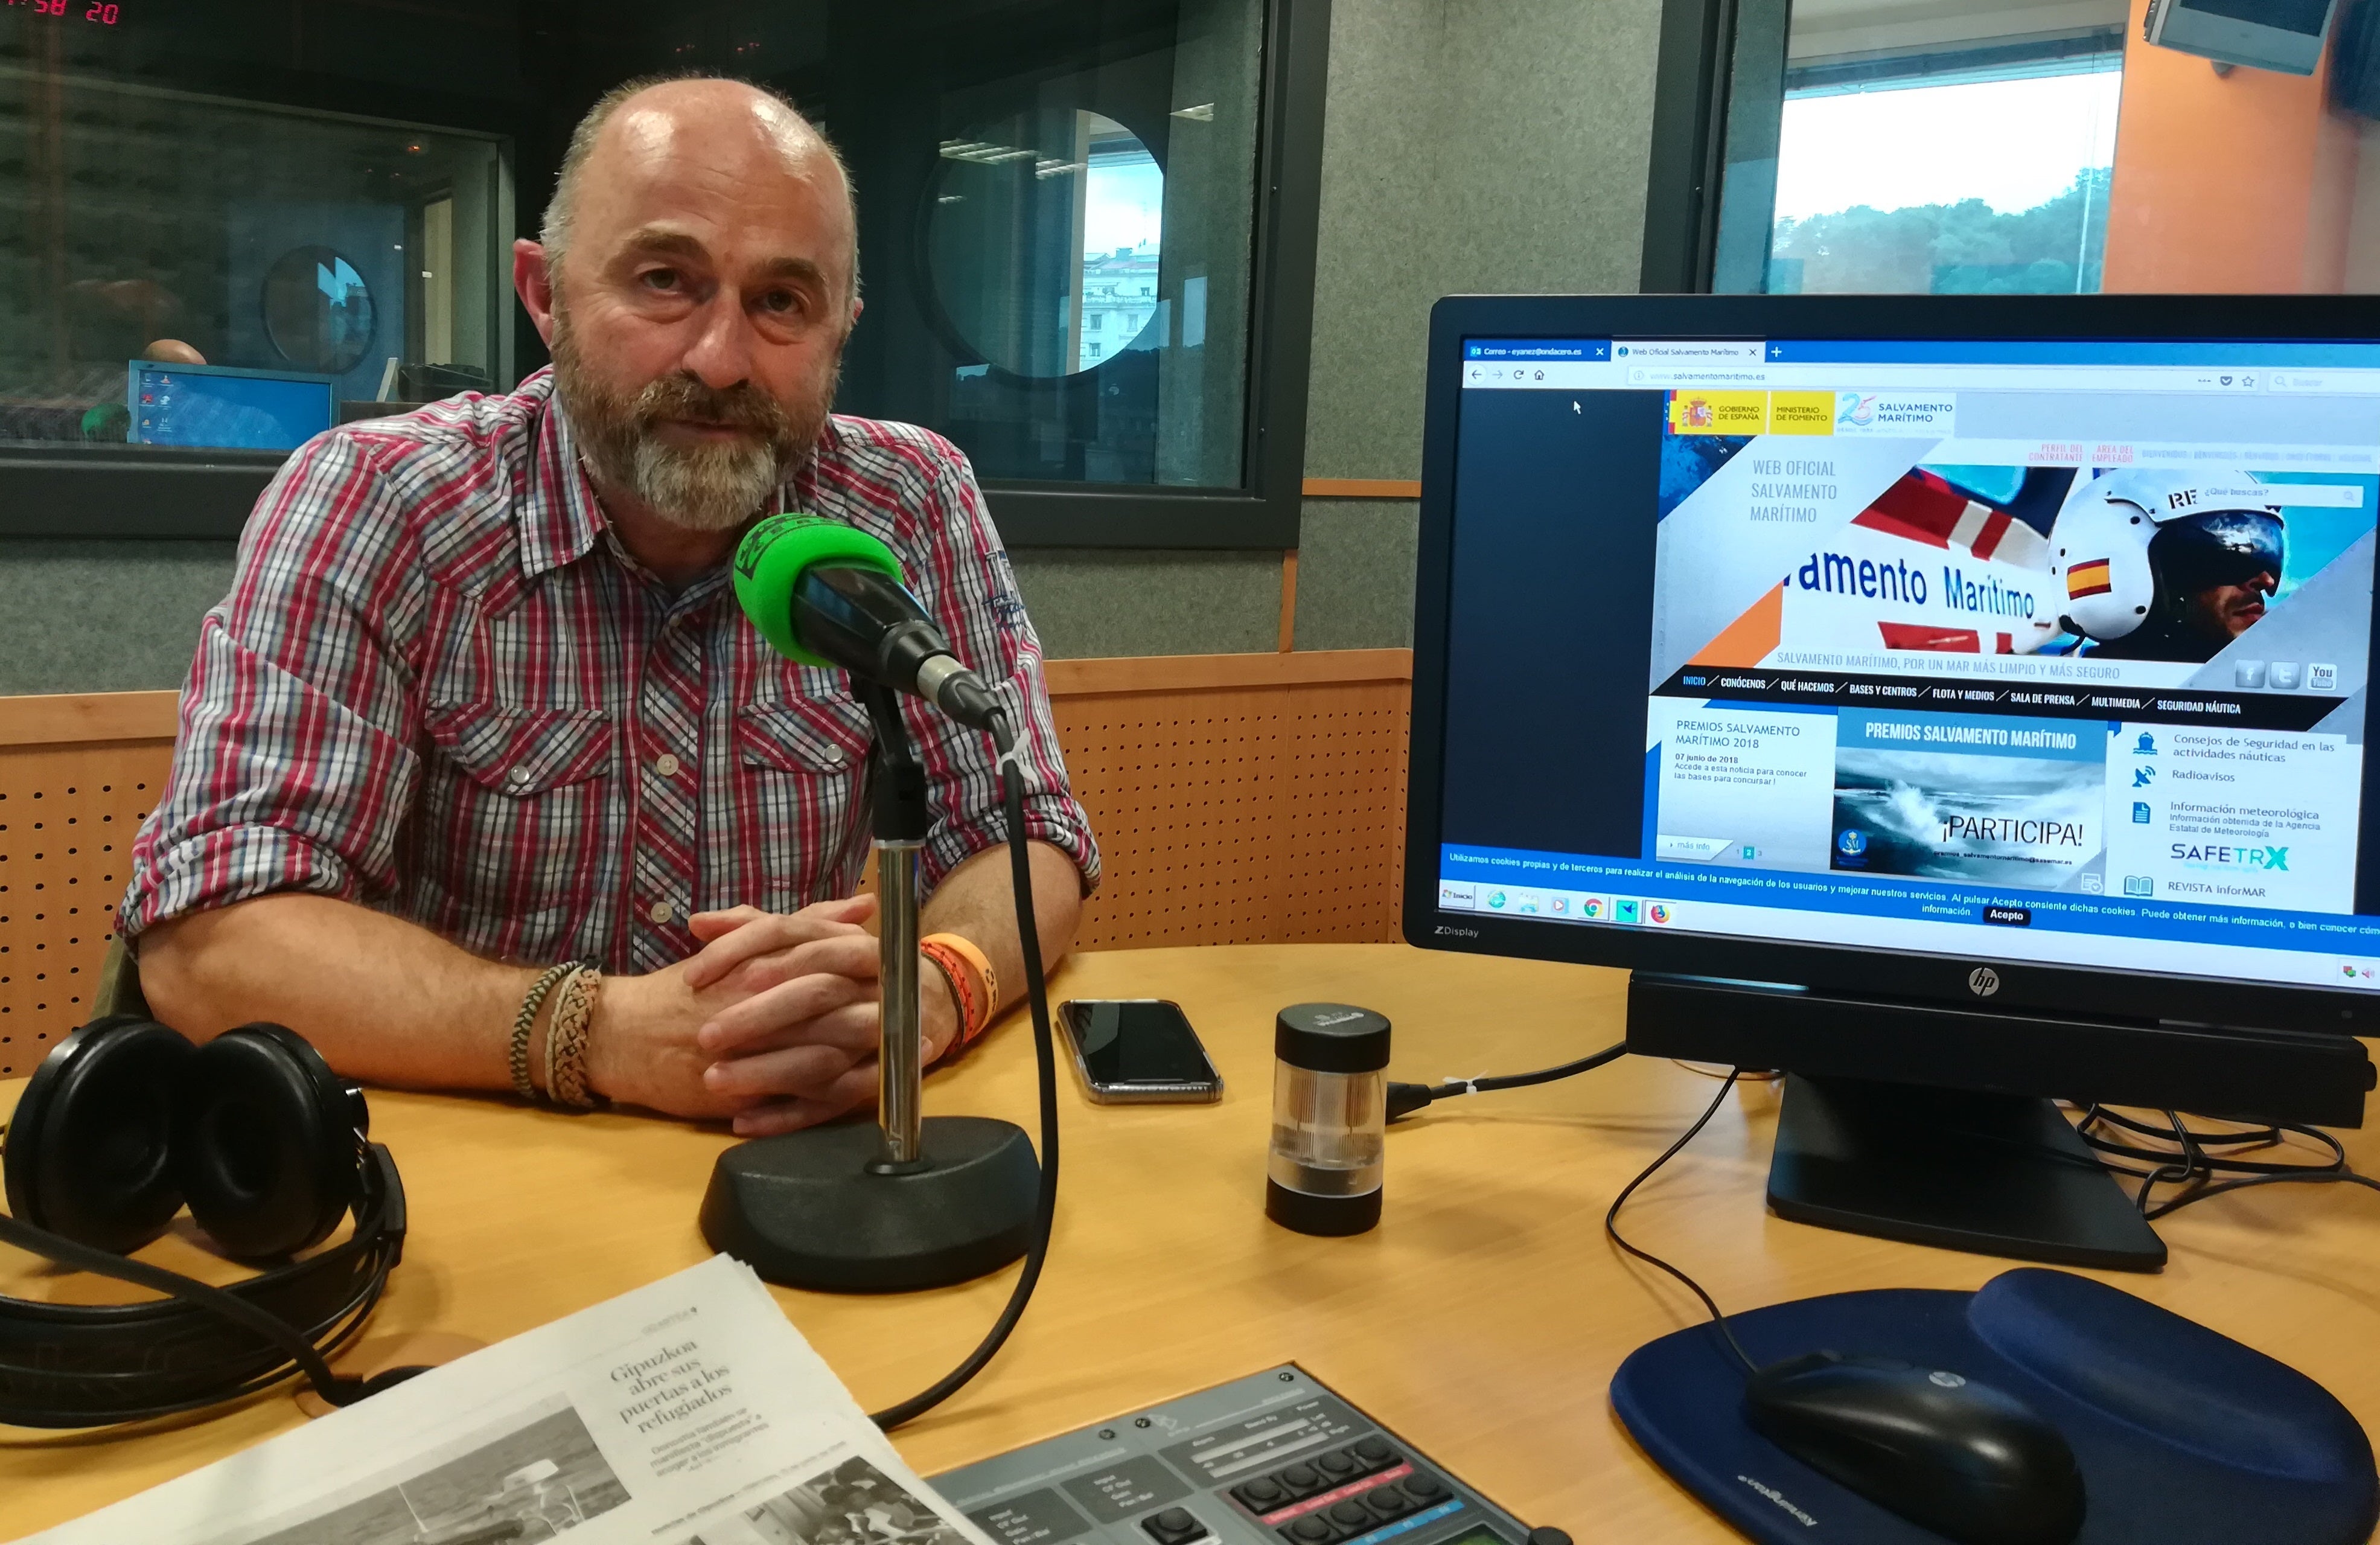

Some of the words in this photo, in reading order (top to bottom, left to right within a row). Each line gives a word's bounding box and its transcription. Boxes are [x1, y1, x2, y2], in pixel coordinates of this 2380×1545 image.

[85, 1, 119, 25] 20
[1878, 403, 1953, 412] SALVAMENTO
[1731, 411, 1759, 421] ESPAÑA
[1878, 412, 1933, 423] MARÍTIMO
[1752, 459, 1781, 476] WEB
[1785, 460, 1836, 477] OFICIAL
[1750, 482, 1837, 501] SALVAMENTO
[2230, 488, 2269, 497] buscas?
[1750, 503, 1817, 523] MARÍTIMO
[1783, 552, 1927, 605] amento
[1944, 565, 2035, 619] Marítimo
[1777, 652, 1843, 666] SALVAMENTO
[1846, 653, 1901, 670] MARÍTIMO,
[1903, 657, 1927, 670] POR
[1929, 659, 1943, 670] UN
[1946, 659, 1970, 672] MAR
[1973, 659, 1996, 673] MÁS
[1999, 663, 2037, 676] LIMPIO
[2039, 665, 2047, 676] Y
[2050, 663, 2073, 677] MÁS
[2076, 666, 2120, 679] SEGURO
[2313, 667, 2332, 677] You
[1683, 676, 1706, 686] INICIO
[1720, 676, 1766, 689] CONÓCENOS
[1781, 678, 1796, 691] QUÉ
[1798, 680, 1834, 693] HACEMOS
[1849, 684, 1874, 695] BASES
[1875, 685, 1881, 695] Y
[1882, 685, 1917, 697] CENTROS
[1932, 688, 1956, 699] FLOTA
[1957, 689, 1964, 699] Y
[1965, 690, 1994, 702] MEDIOS
[2011, 692, 2031, 703] SALA
[2032, 693, 2043, 704] DE
[2044, 694, 2075, 706] PRENSA
[2091, 696, 2140, 709] MULTIMEDIA
[2157, 700, 2204, 712] SEGURIDAD
[2206, 700, 2241, 714] NÁUTICA
[1677, 720, 1723, 732] PREMIOS
[1727, 723, 1800, 737] SALVAMENTO
[1865, 721, 1921, 741] PREMIOS
[1924, 725, 2008, 746] SALVAMENTO
[2011, 729, 2076, 750] MARÍTIMO
[1676, 733, 1729, 747] MARÍTIMO
[1734, 738, 1759, 748] 2018
[2174, 734, 2222, 747] Consejos
[2225, 737, 2240, 746] de
[2244, 738, 2299, 750] Seguridad
[2302, 742, 2316, 750] en
[2319, 741, 2335, 752] las
[1686, 753, 1706, 763] junio
[2173, 749, 2236, 760] actividades
[2239, 750, 2286, 763] náuticas
[1674, 763, 1702, 771] Accede
[1729, 766, 1755, 775] noticia
[1756, 768, 1774, 776] para
[1776, 769, 1807, 778] conocer
[2172, 769, 2235, 782] Radioavisos
[1733, 776, 1772, 785] concursar
[2170, 801, 2236, 815] Información
[2239, 805, 2320, 820] meteorológica
[2169, 813, 2221, 825] Información
[2222, 816, 2260, 828] obtenida
[2262, 819, 2273, 828] de
[2275, 820, 2283, 829] la
[2285, 820, 2321, 831] Agencia
[1942, 814, 2084, 846] ¡PARTICIPA!
[2169, 824, 2198, 833] Estatal
[2201, 825, 2212, 834] de
[2214, 826, 2270, 839] Meteorología
[1449, 852, 1489, 865] Utilizamos
[1491, 856, 1520, 867] cookies
[1522, 859, 1551, 871] propias
[1560, 862, 1569, 871] de
[1571, 863, 1603, 874] terceros
[1605, 867, 1622, 876] para
[1624, 868, 1653, 878] realizar
[1656, 869, 1662, 878] el
[1665, 871, 1695, 881] análisis
[1697, 872, 1708, 882] de
[1709, 873, 1717, 883] la
[1719, 875, 1764, 888] navegación
[1766, 878, 1776, 888] de
[1778, 879, 1791, 889] los
[1793, 881, 1828, 892] usuarios
[1830, 886, 1836, 894] y
[1838, 884, 1869, 896] mejorar
[1871, 888, 1907, 898] nuestros
[1951, 893, 1961, 902] Al
[1963, 894, 1990, 906] pulsar
[1992, 896, 2023, 909] Acepto
[2025, 900, 2067, 912] consiente
[2070, 903, 2098, 913] dichas
[2142, 909, 2170, 919] Puede
[2173, 911, 2207, 922] obtener
[2209, 913, 2228, 924] más
[2232, 916, 2286, 930] información,
[2298, 921, 2317, 931] bien
[2320, 923, 2358, 933] conocer
[2168, 881, 2213, 894] REVISTA
[1990, 909, 2024, 921] Acepto
[1973, 967, 1996, 996] hp
[610, 1342, 698, 1381] Gipuzkoa
[629, 1372, 668, 1396] abre
[671, 1359, 700, 1376] sus
[619, 1384, 689, 1424] puertas
[690, 1378, 703, 1389] a
[700, 1366, 730, 1383] los
[637, 1385, 732, 1433] refugiados
